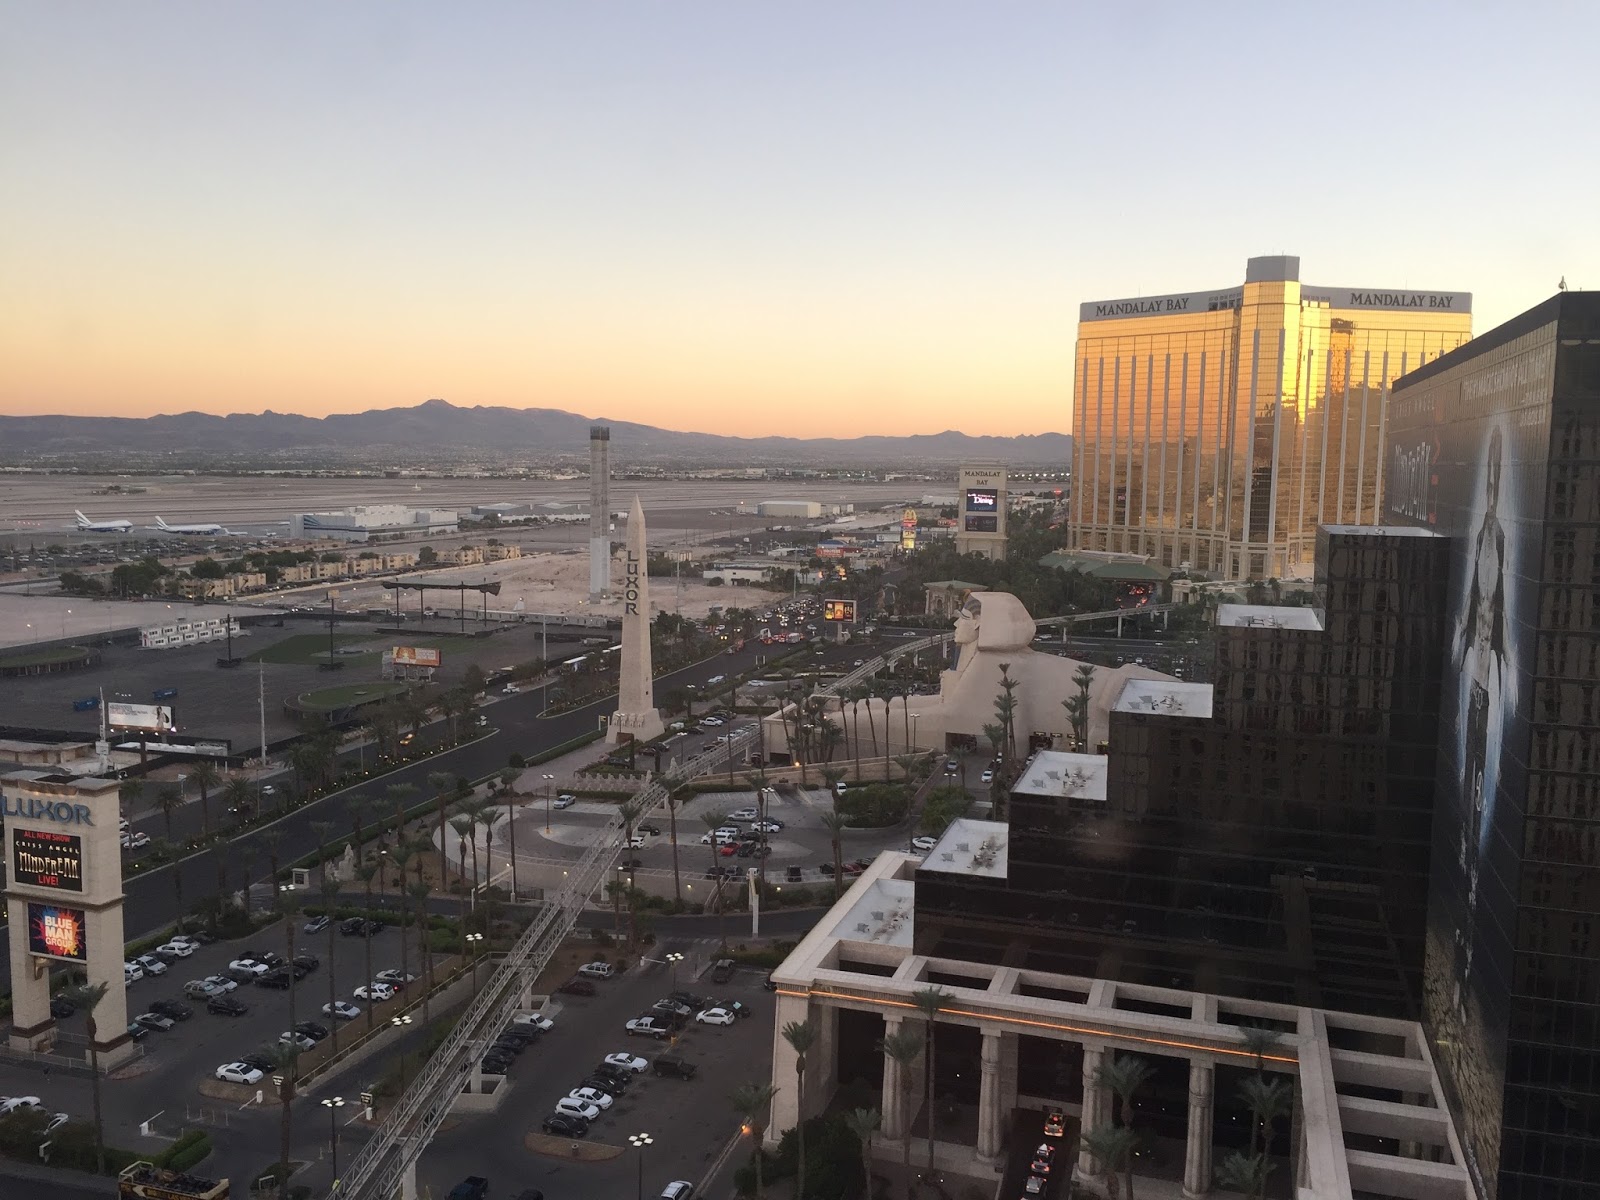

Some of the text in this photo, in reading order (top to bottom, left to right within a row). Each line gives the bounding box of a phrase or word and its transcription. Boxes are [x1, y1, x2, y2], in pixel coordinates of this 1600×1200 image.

[1095, 297, 1190, 317] MANDALAY BAY
[1350, 292, 1454, 308] MANDALAY BAY
[625, 550, 640, 615] LUXOR
[1, 795, 96, 827] LUXOR
[36, 832, 51, 840] NEW
[51, 834, 71, 842] SHOW
[15, 840, 80, 855] CRISS ANGEL
[18, 851, 79, 879] MINDFREAK
[38, 875, 59, 886] LIVE!
[44, 915, 73, 929] BLUE
[45, 925, 73, 940] MAN
[45, 937, 74, 948] GROUP
